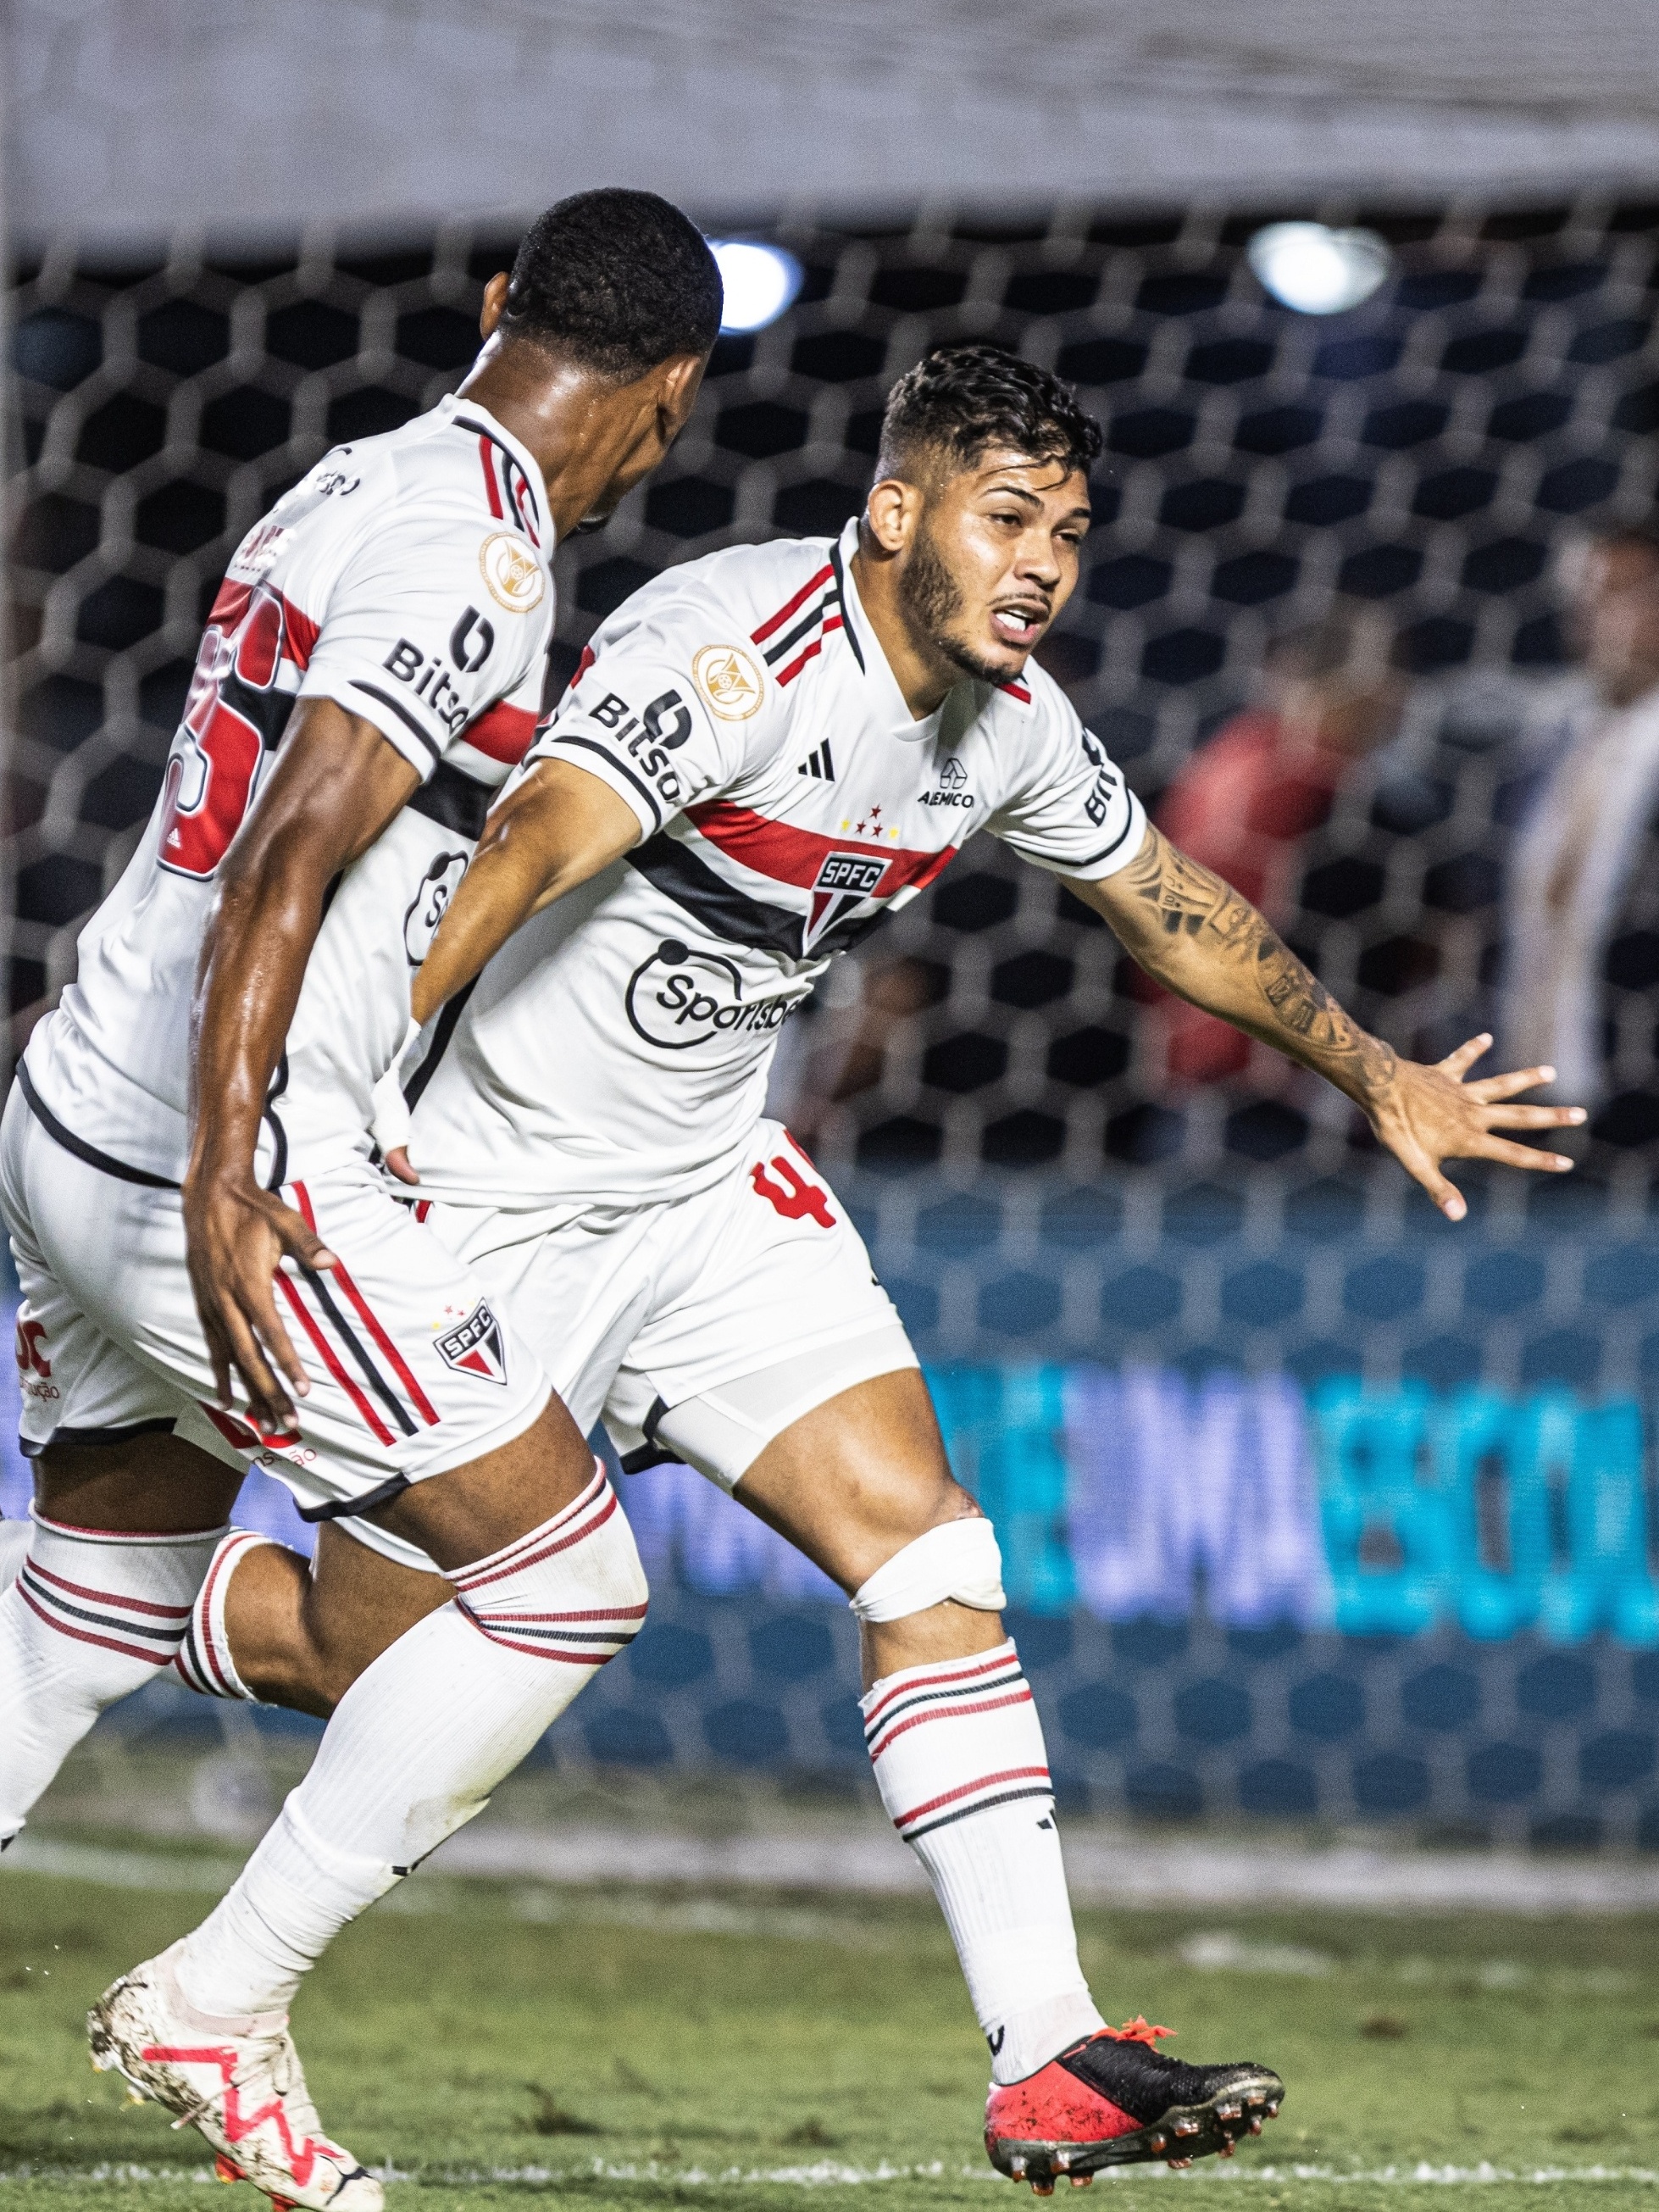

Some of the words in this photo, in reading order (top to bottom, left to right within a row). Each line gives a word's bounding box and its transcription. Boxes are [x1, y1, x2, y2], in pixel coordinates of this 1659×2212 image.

[587, 692, 680, 801] Bitso
[821, 861, 881, 888] SPFC
[749, 1128, 837, 1230] 4
[443, 1307, 491, 1357] SPFC
